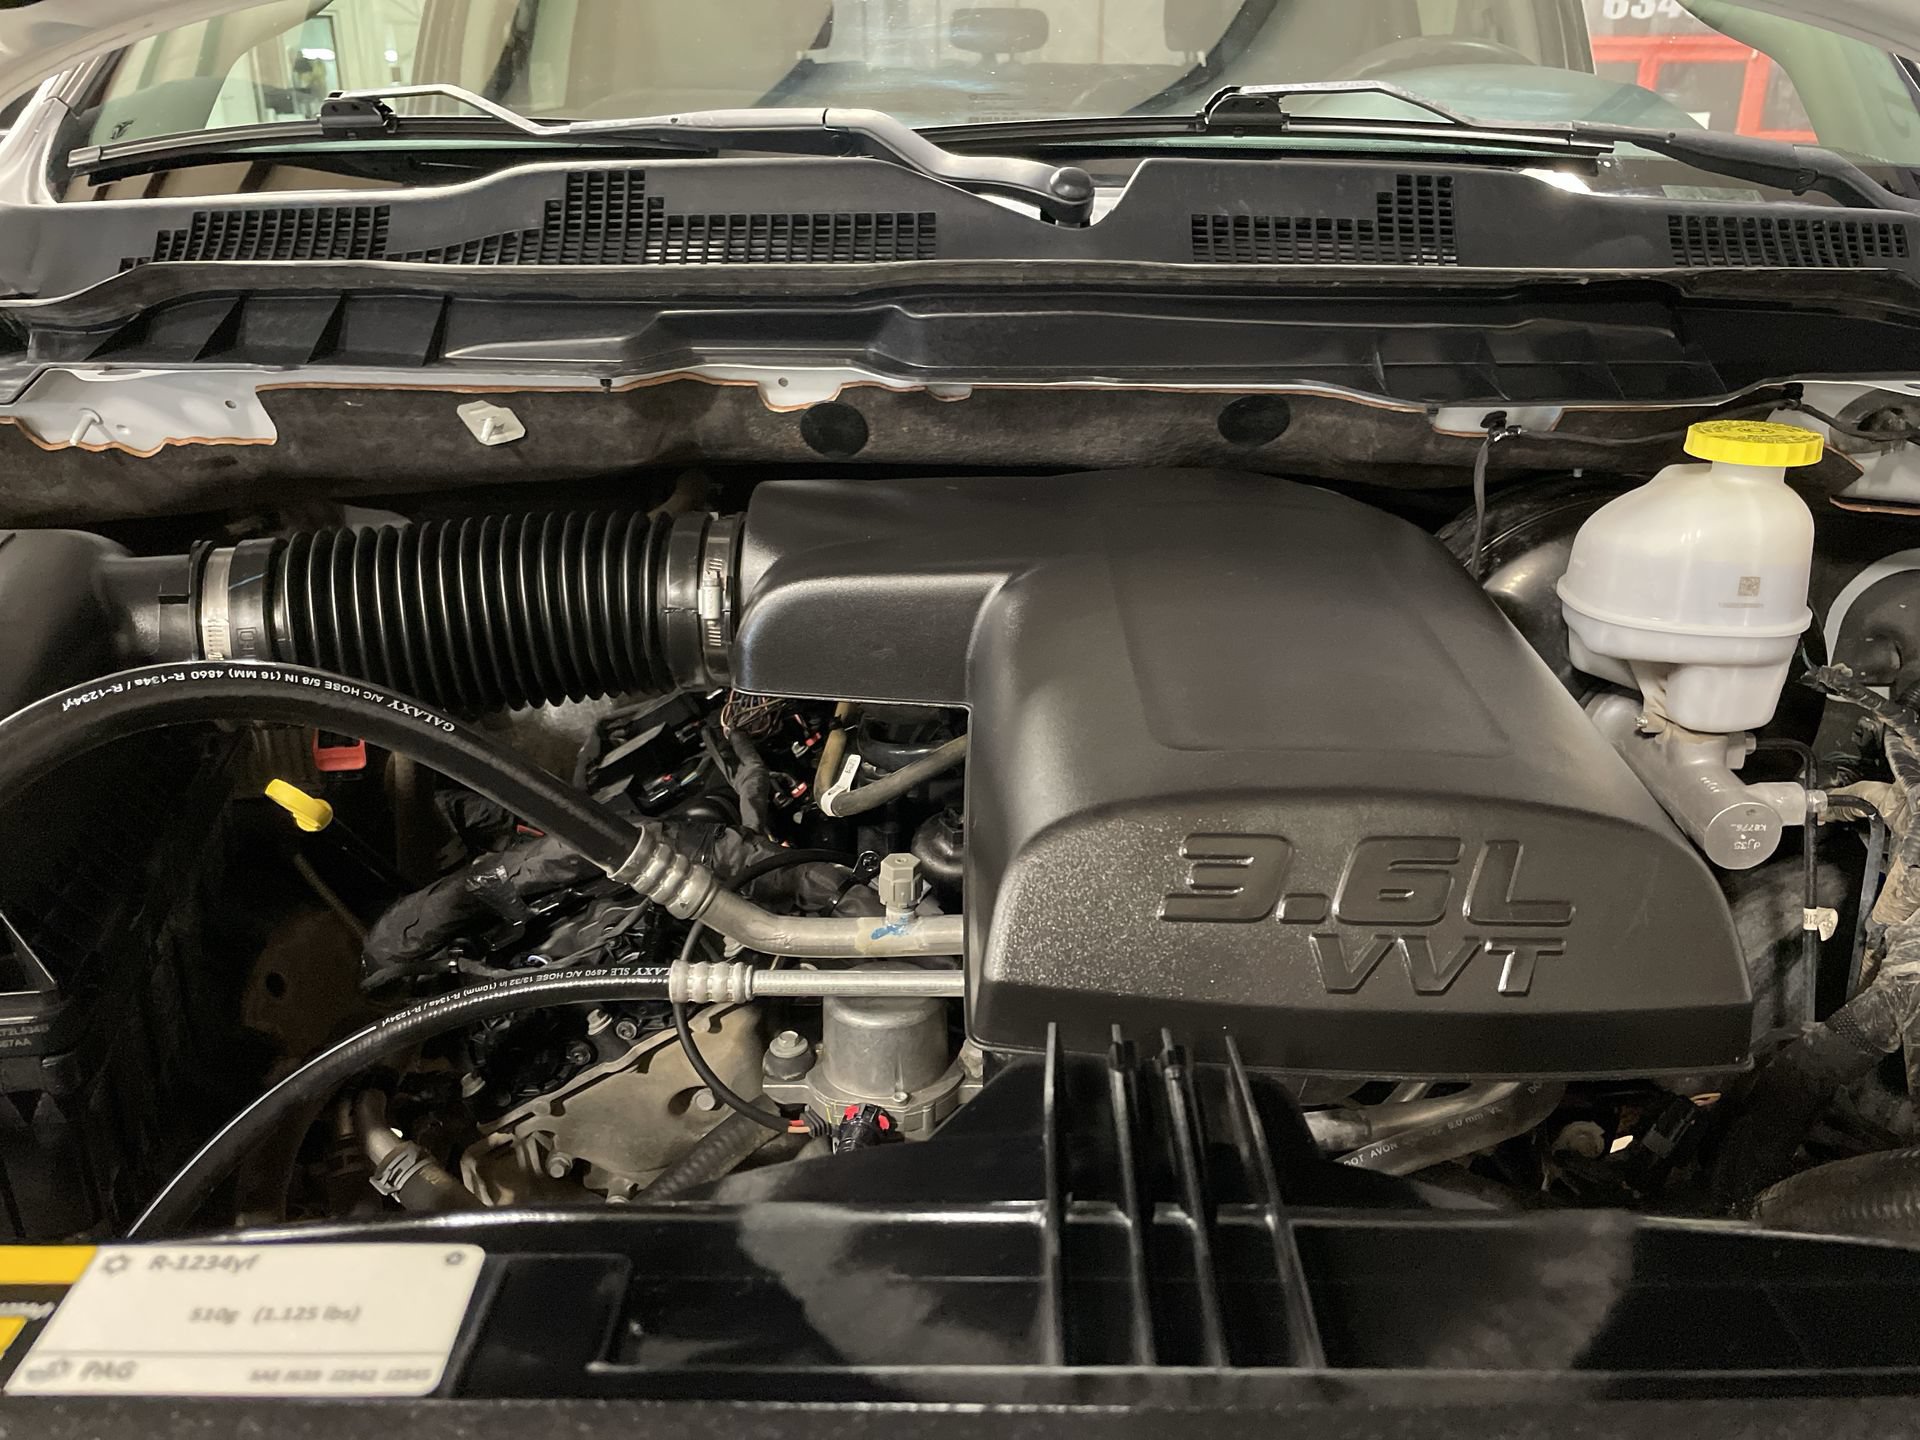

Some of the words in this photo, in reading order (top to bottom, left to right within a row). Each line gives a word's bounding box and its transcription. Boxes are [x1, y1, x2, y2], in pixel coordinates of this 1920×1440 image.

[134, 672, 185, 687] R-134a
[191, 669, 224, 680] 4860
[228, 669, 257, 680] MM)
[261, 671, 281, 681] (16
[284, 673, 298, 683] IN
[302, 676, 321, 687] 5/8
[324, 680, 360, 697] HOSE
[61, 683, 124, 712] R-1234yf
[362, 690, 385, 703] A/C
[386, 699, 455, 732] GALAXY
[1158, 832, 1576, 927] 3.6L
[610, 967, 630, 976] SLE
[1309, 933, 1567, 996] VVT
[509, 975, 534, 986] 13/32
[536, 972, 564, 982] HOSE
[566, 970, 583, 979] A/C
[463, 981, 497, 996] (10mm)
[429, 991, 461, 1007] R-134a
[381, 1005, 422, 1028] R-1234yf
[148, 1253, 260, 1276] R-1234yf
[322, 1305, 362, 1325] lbs)
